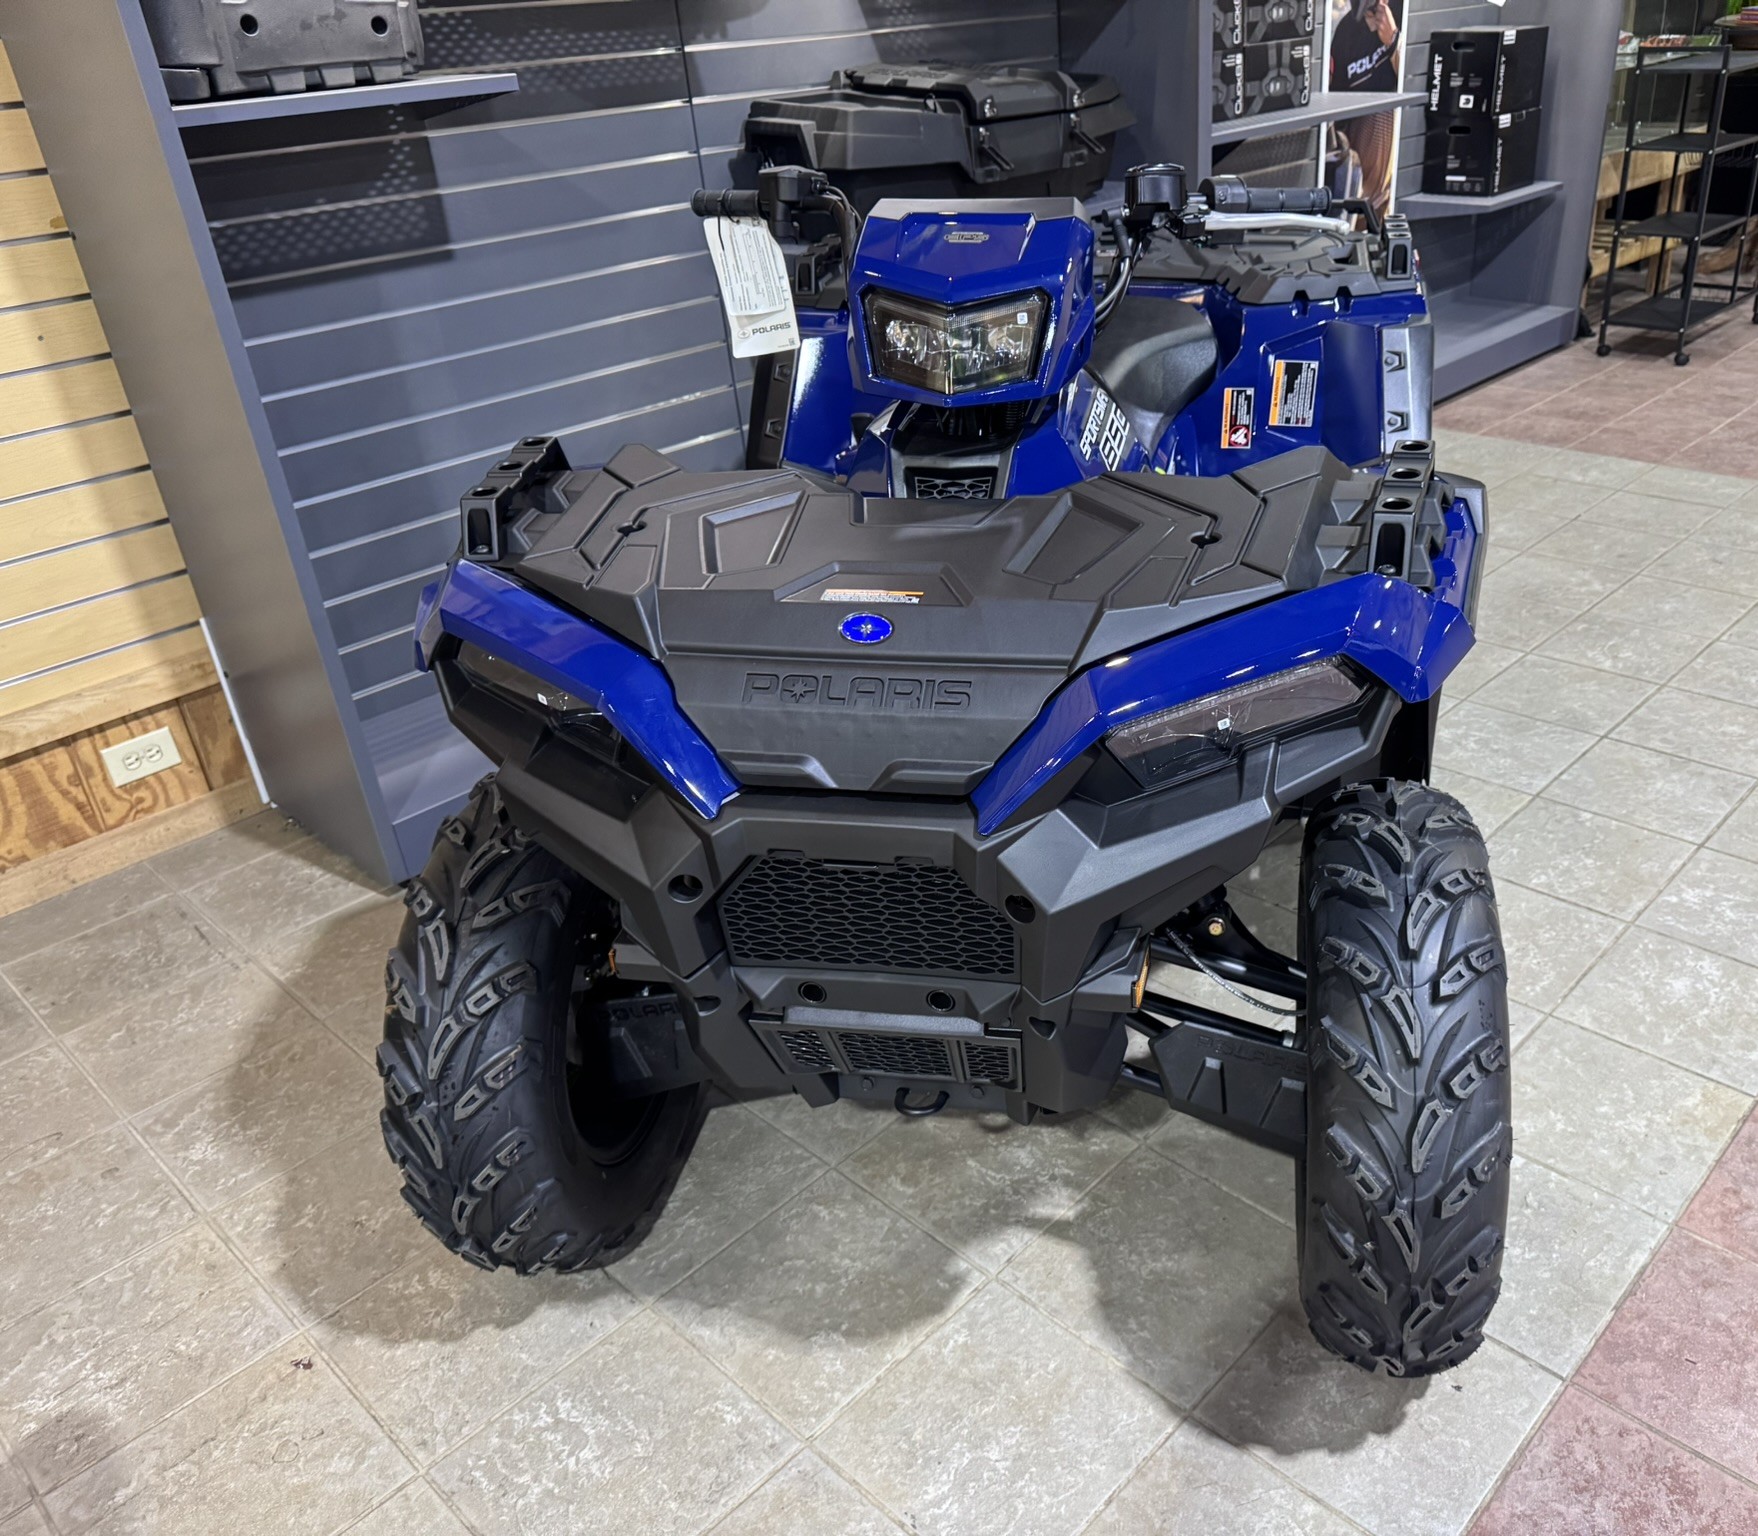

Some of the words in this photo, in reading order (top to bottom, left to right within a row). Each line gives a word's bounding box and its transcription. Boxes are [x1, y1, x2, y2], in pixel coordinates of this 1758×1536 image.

[1430, 53, 1443, 112] HELMET
[1495, 54, 1507, 113] HELMET
[1493, 137, 1503, 193] HELMET
[752, 322, 791, 335] POLARIS
[741, 673, 973, 712] POLARIS
